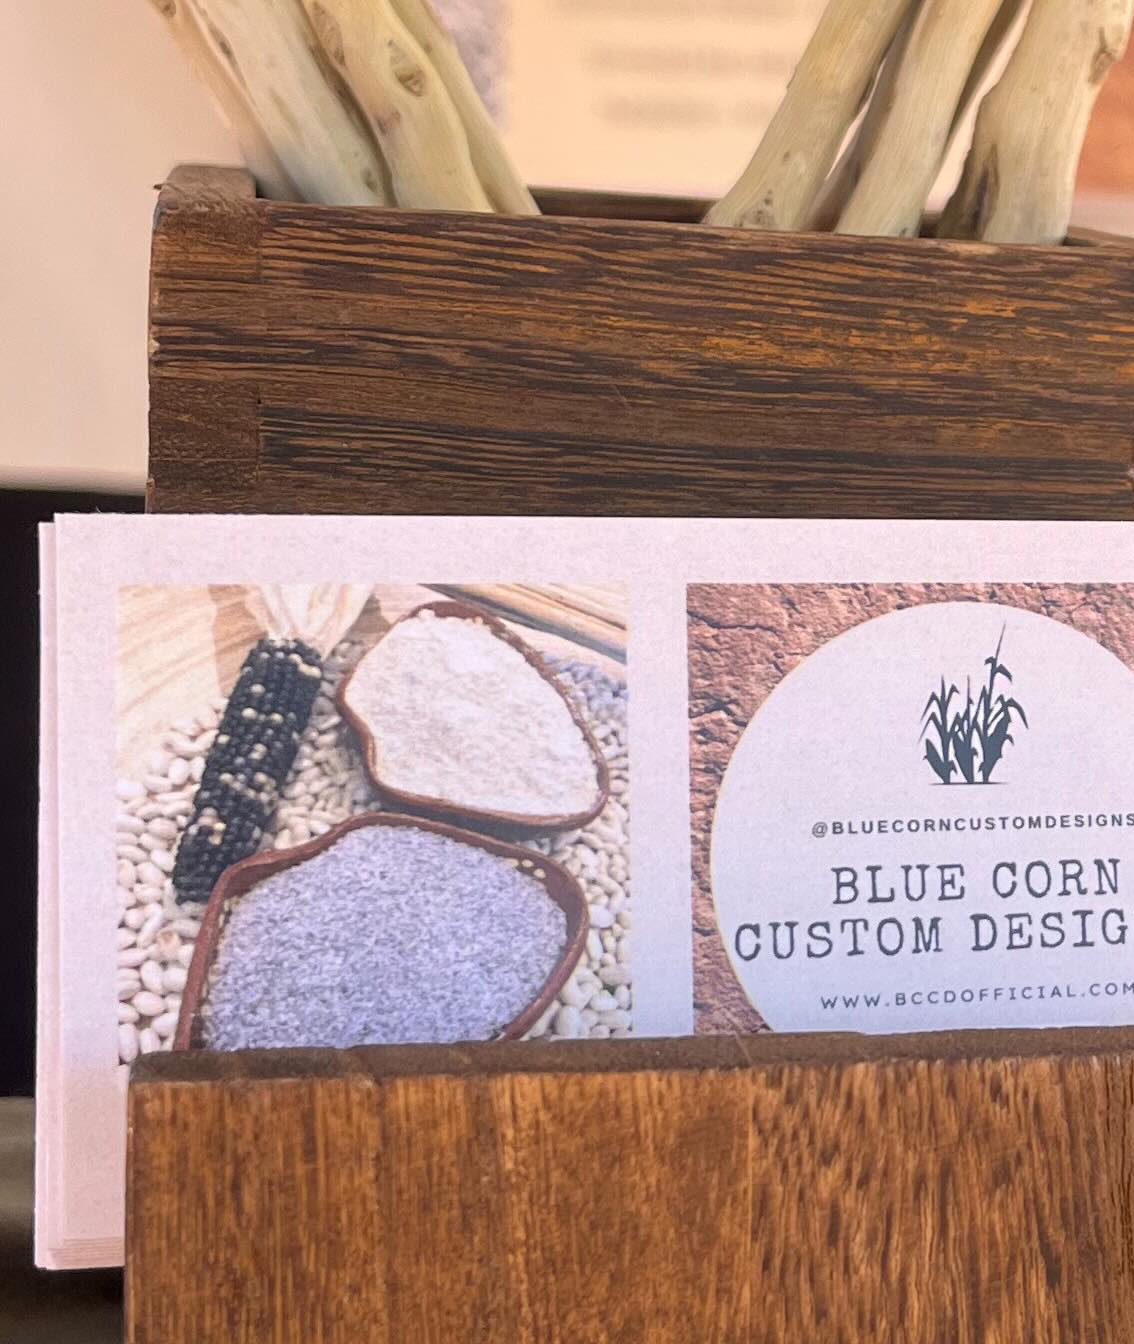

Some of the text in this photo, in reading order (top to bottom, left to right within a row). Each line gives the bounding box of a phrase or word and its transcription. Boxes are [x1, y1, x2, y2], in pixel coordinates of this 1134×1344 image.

[831, 859, 1121, 905] BLUE CORN
[733, 917, 944, 962] CUSTOM
